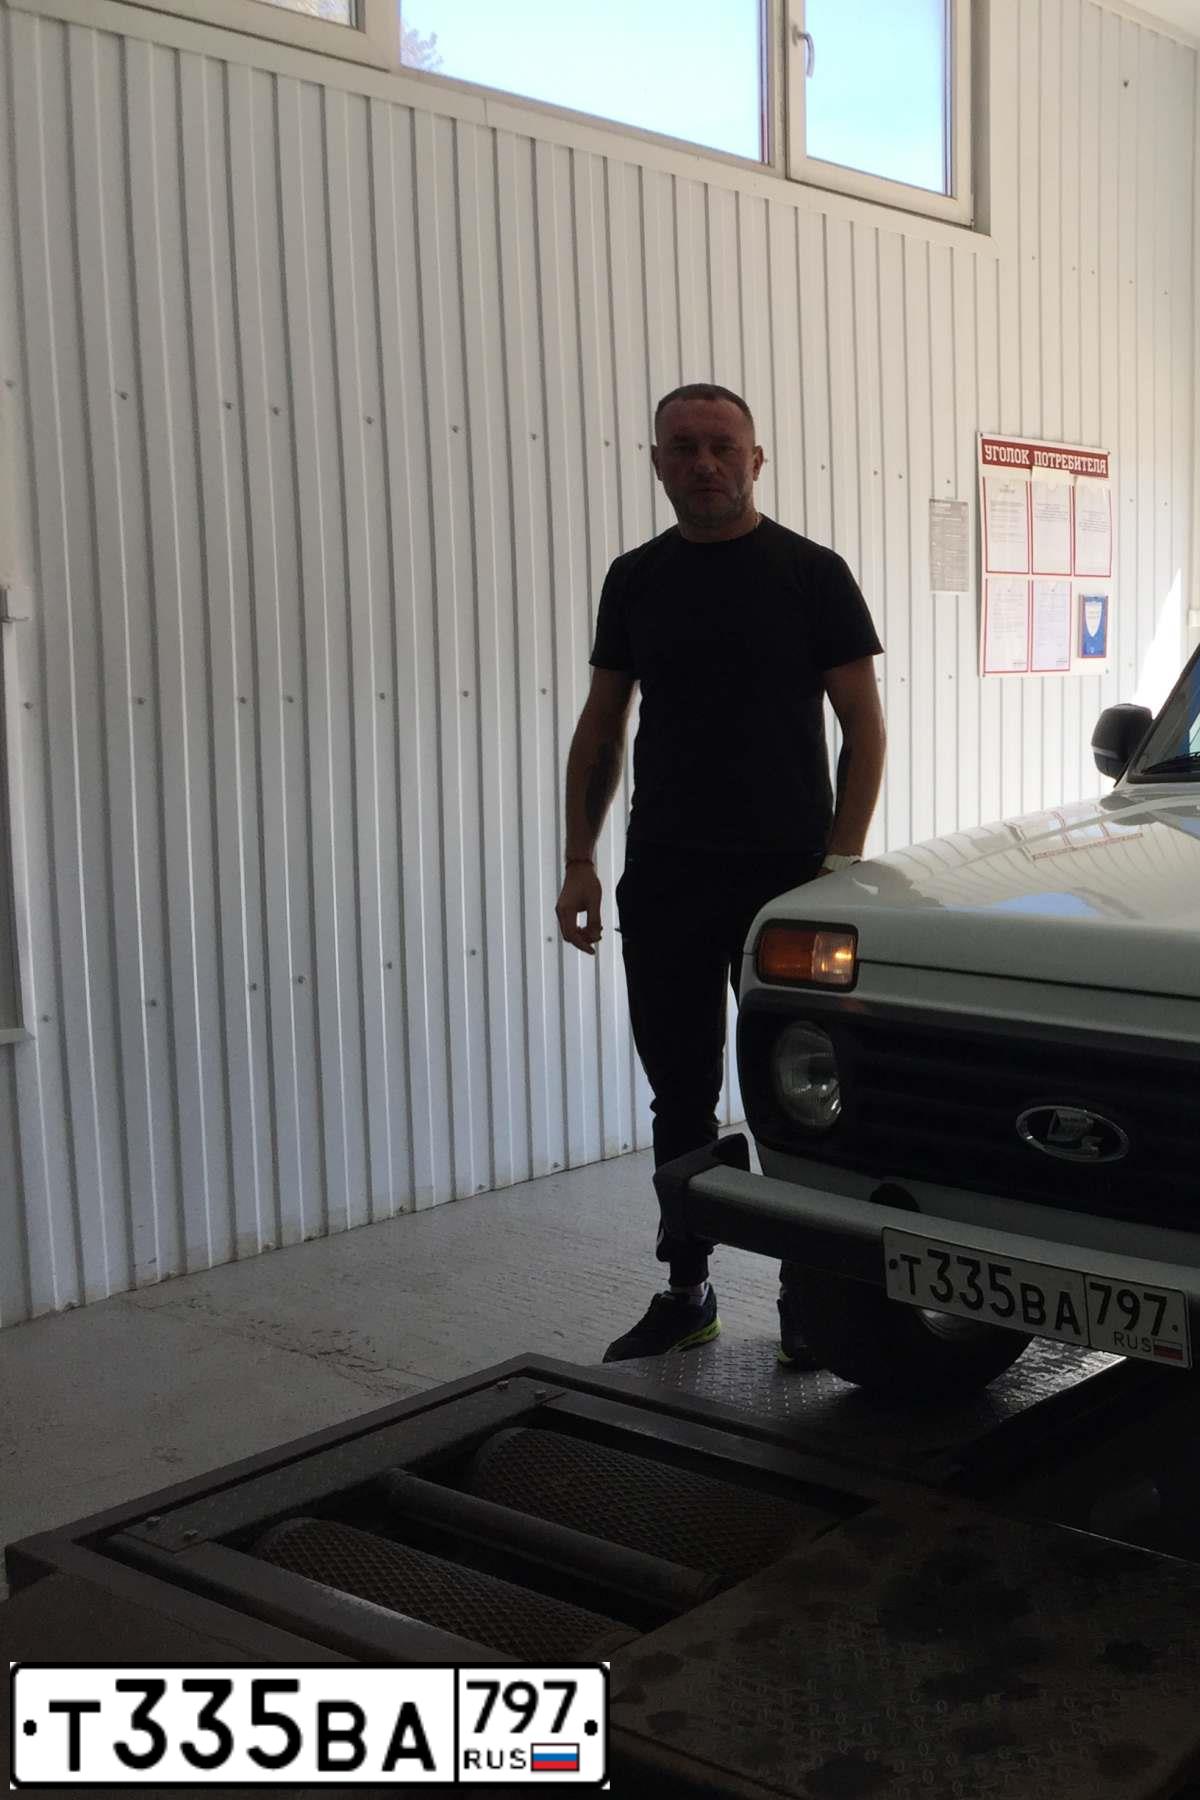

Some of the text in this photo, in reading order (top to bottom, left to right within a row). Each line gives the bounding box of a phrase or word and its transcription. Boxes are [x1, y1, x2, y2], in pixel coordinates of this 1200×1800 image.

[984, 444, 1107, 474] УГОЛОК ПОТРЕБИТЕЛЯ
[900, 1249, 1168, 1336] Т335ВА 797
[1113, 1331, 1152, 1352] RUS
